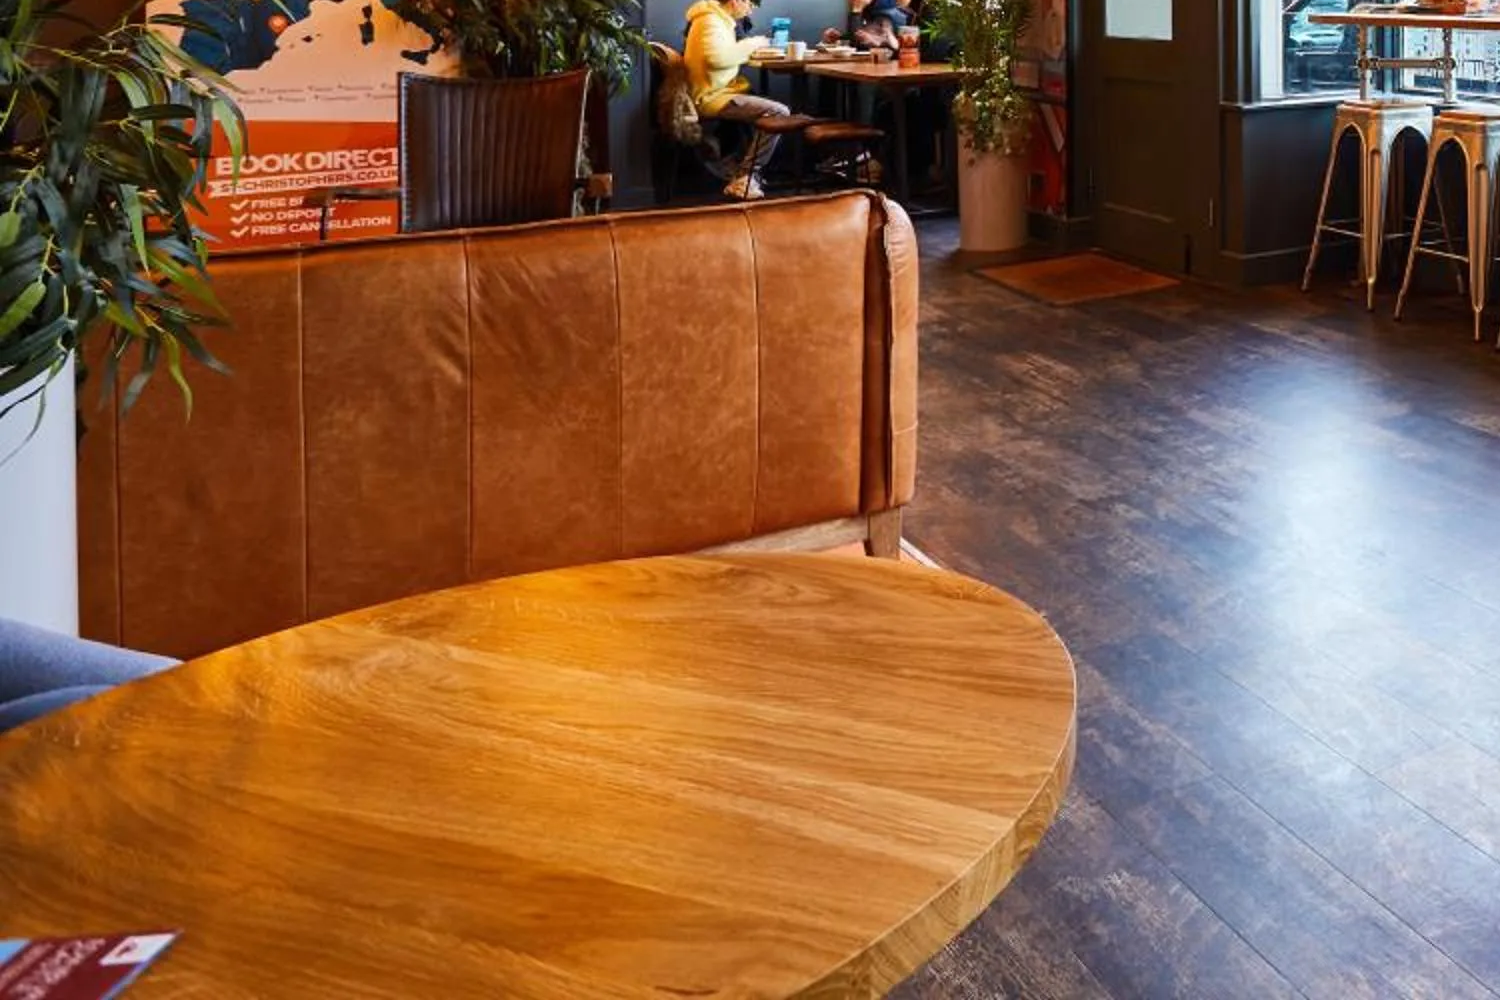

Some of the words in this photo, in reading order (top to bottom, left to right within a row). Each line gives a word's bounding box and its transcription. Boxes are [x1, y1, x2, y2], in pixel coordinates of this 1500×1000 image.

[215, 153, 303, 176] BOOK
[304, 147, 398, 172] DIRECT
[251, 197, 287, 209] FREE
[251, 211, 274, 223] NO
[276, 207, 337, 220] DEPOT
[251, 224, 287, 236] FREE
[288, 215, 392, 233] CANELLATION
